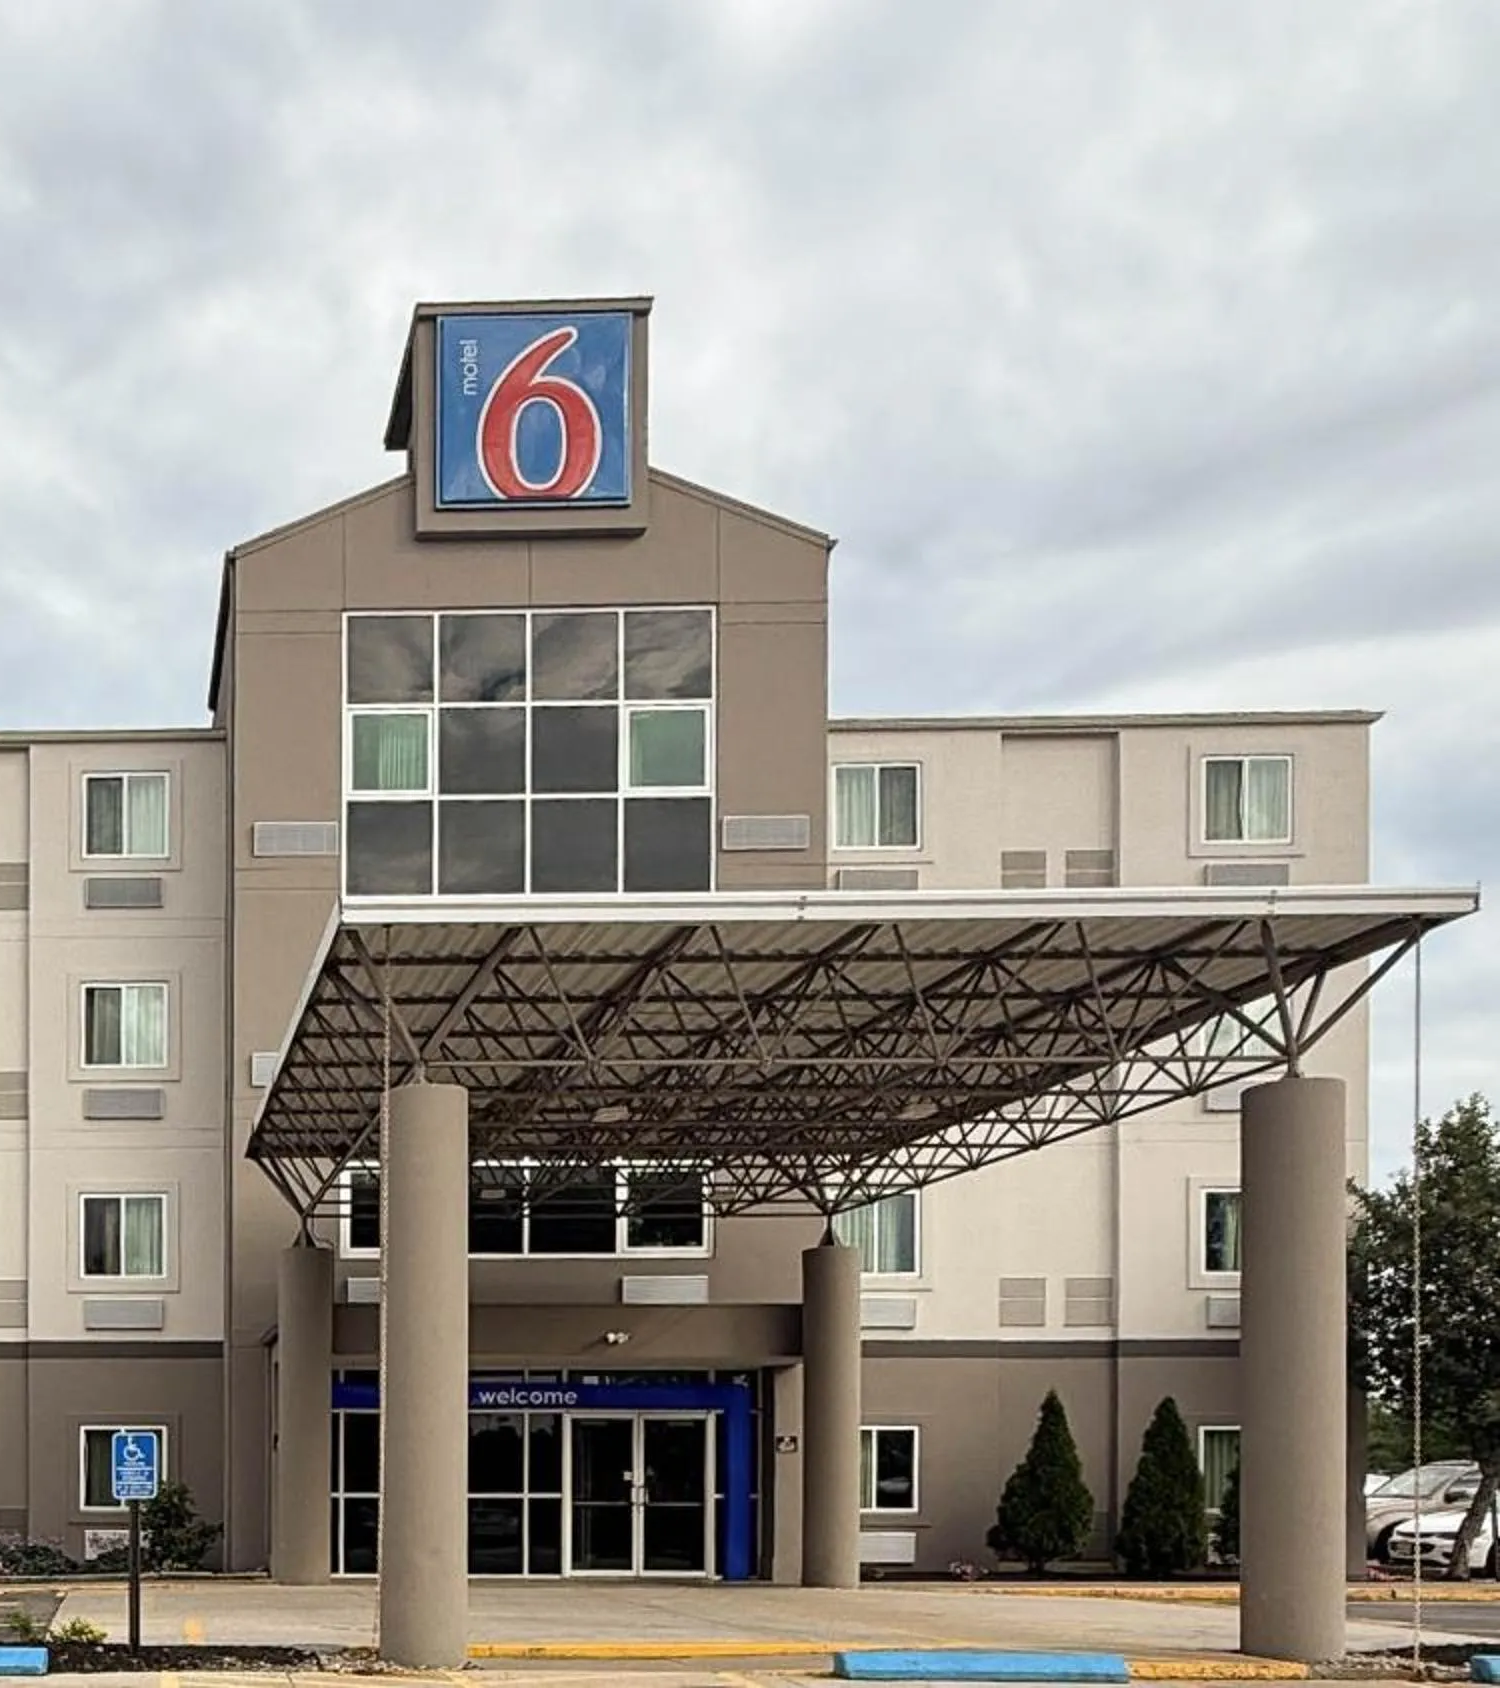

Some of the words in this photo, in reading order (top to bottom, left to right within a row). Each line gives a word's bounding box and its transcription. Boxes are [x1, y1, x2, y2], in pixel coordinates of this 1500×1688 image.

[460, 339, 477, 395] motel
[476, 326, 602, 500] 6
[478, 1387, 578, 1405] welcome
